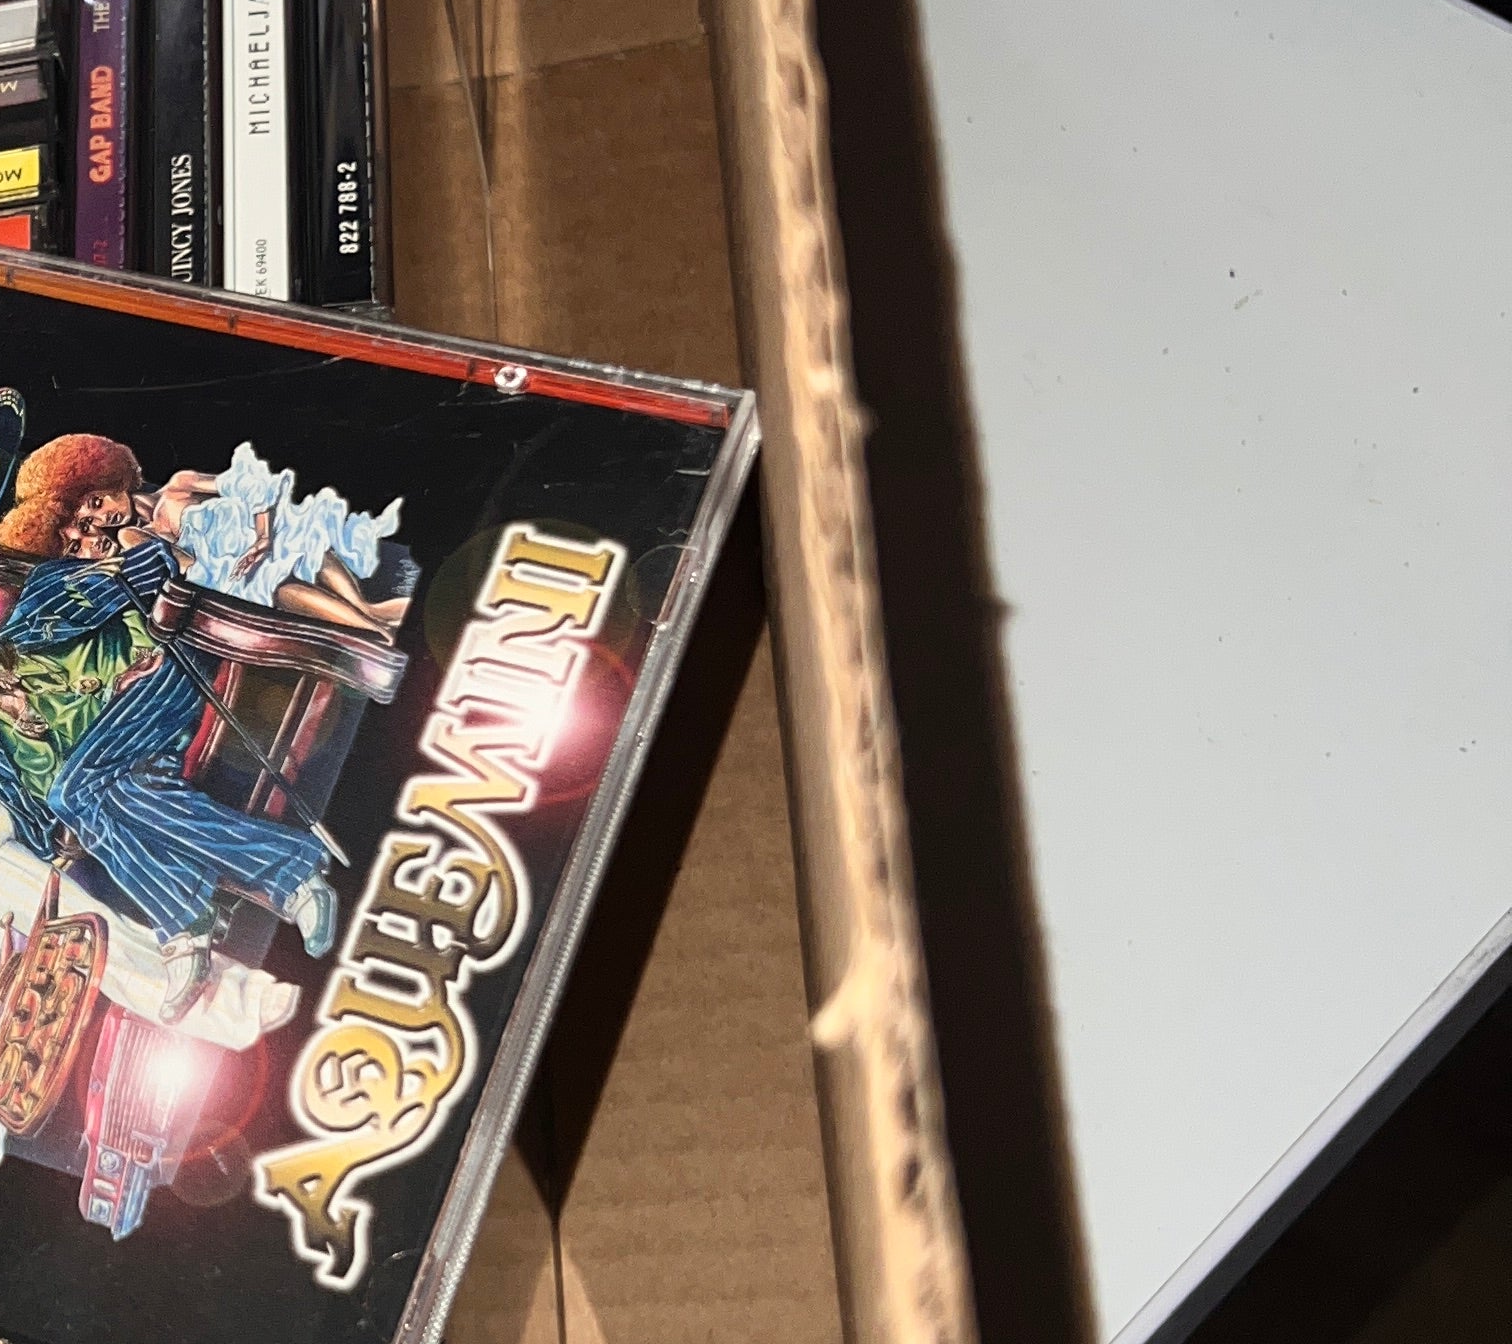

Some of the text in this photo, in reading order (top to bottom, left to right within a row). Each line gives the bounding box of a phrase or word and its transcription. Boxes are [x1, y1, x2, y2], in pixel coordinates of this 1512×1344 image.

[90, 65, 114, 130] BAND
[88, 135, 114, 184] GAP
[170, 153, 192, 216] JONES
[257, 238, 269, 276] 69400
[338, 220, 360, 255] 822
[254, 519, 628, 1291] AQUEMINI
